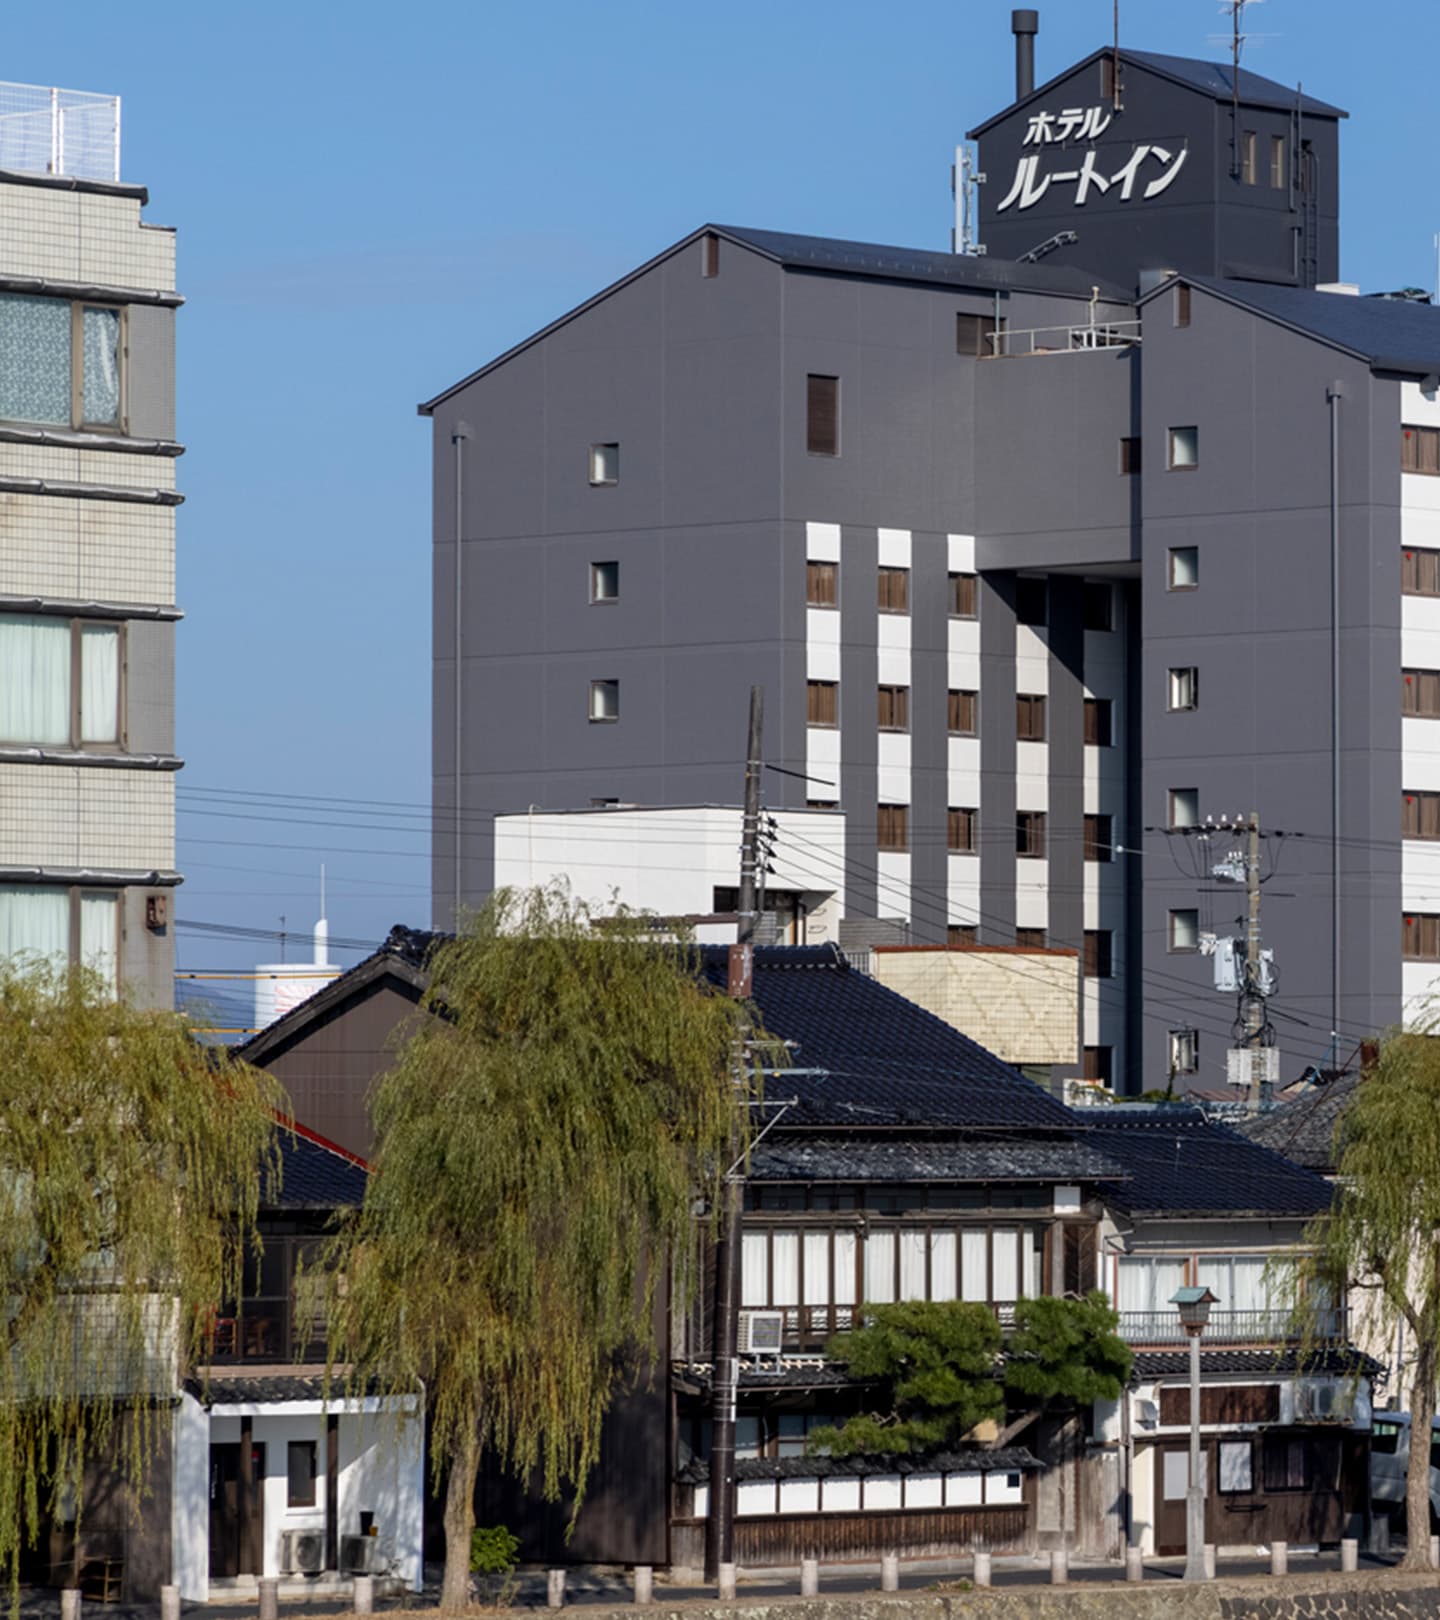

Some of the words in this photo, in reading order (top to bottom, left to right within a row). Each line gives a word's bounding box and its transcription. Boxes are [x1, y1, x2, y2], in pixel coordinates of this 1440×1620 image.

[1022, 106, 1111, 145] ホテル
[997, 144, 1187, 212] ルートイン
